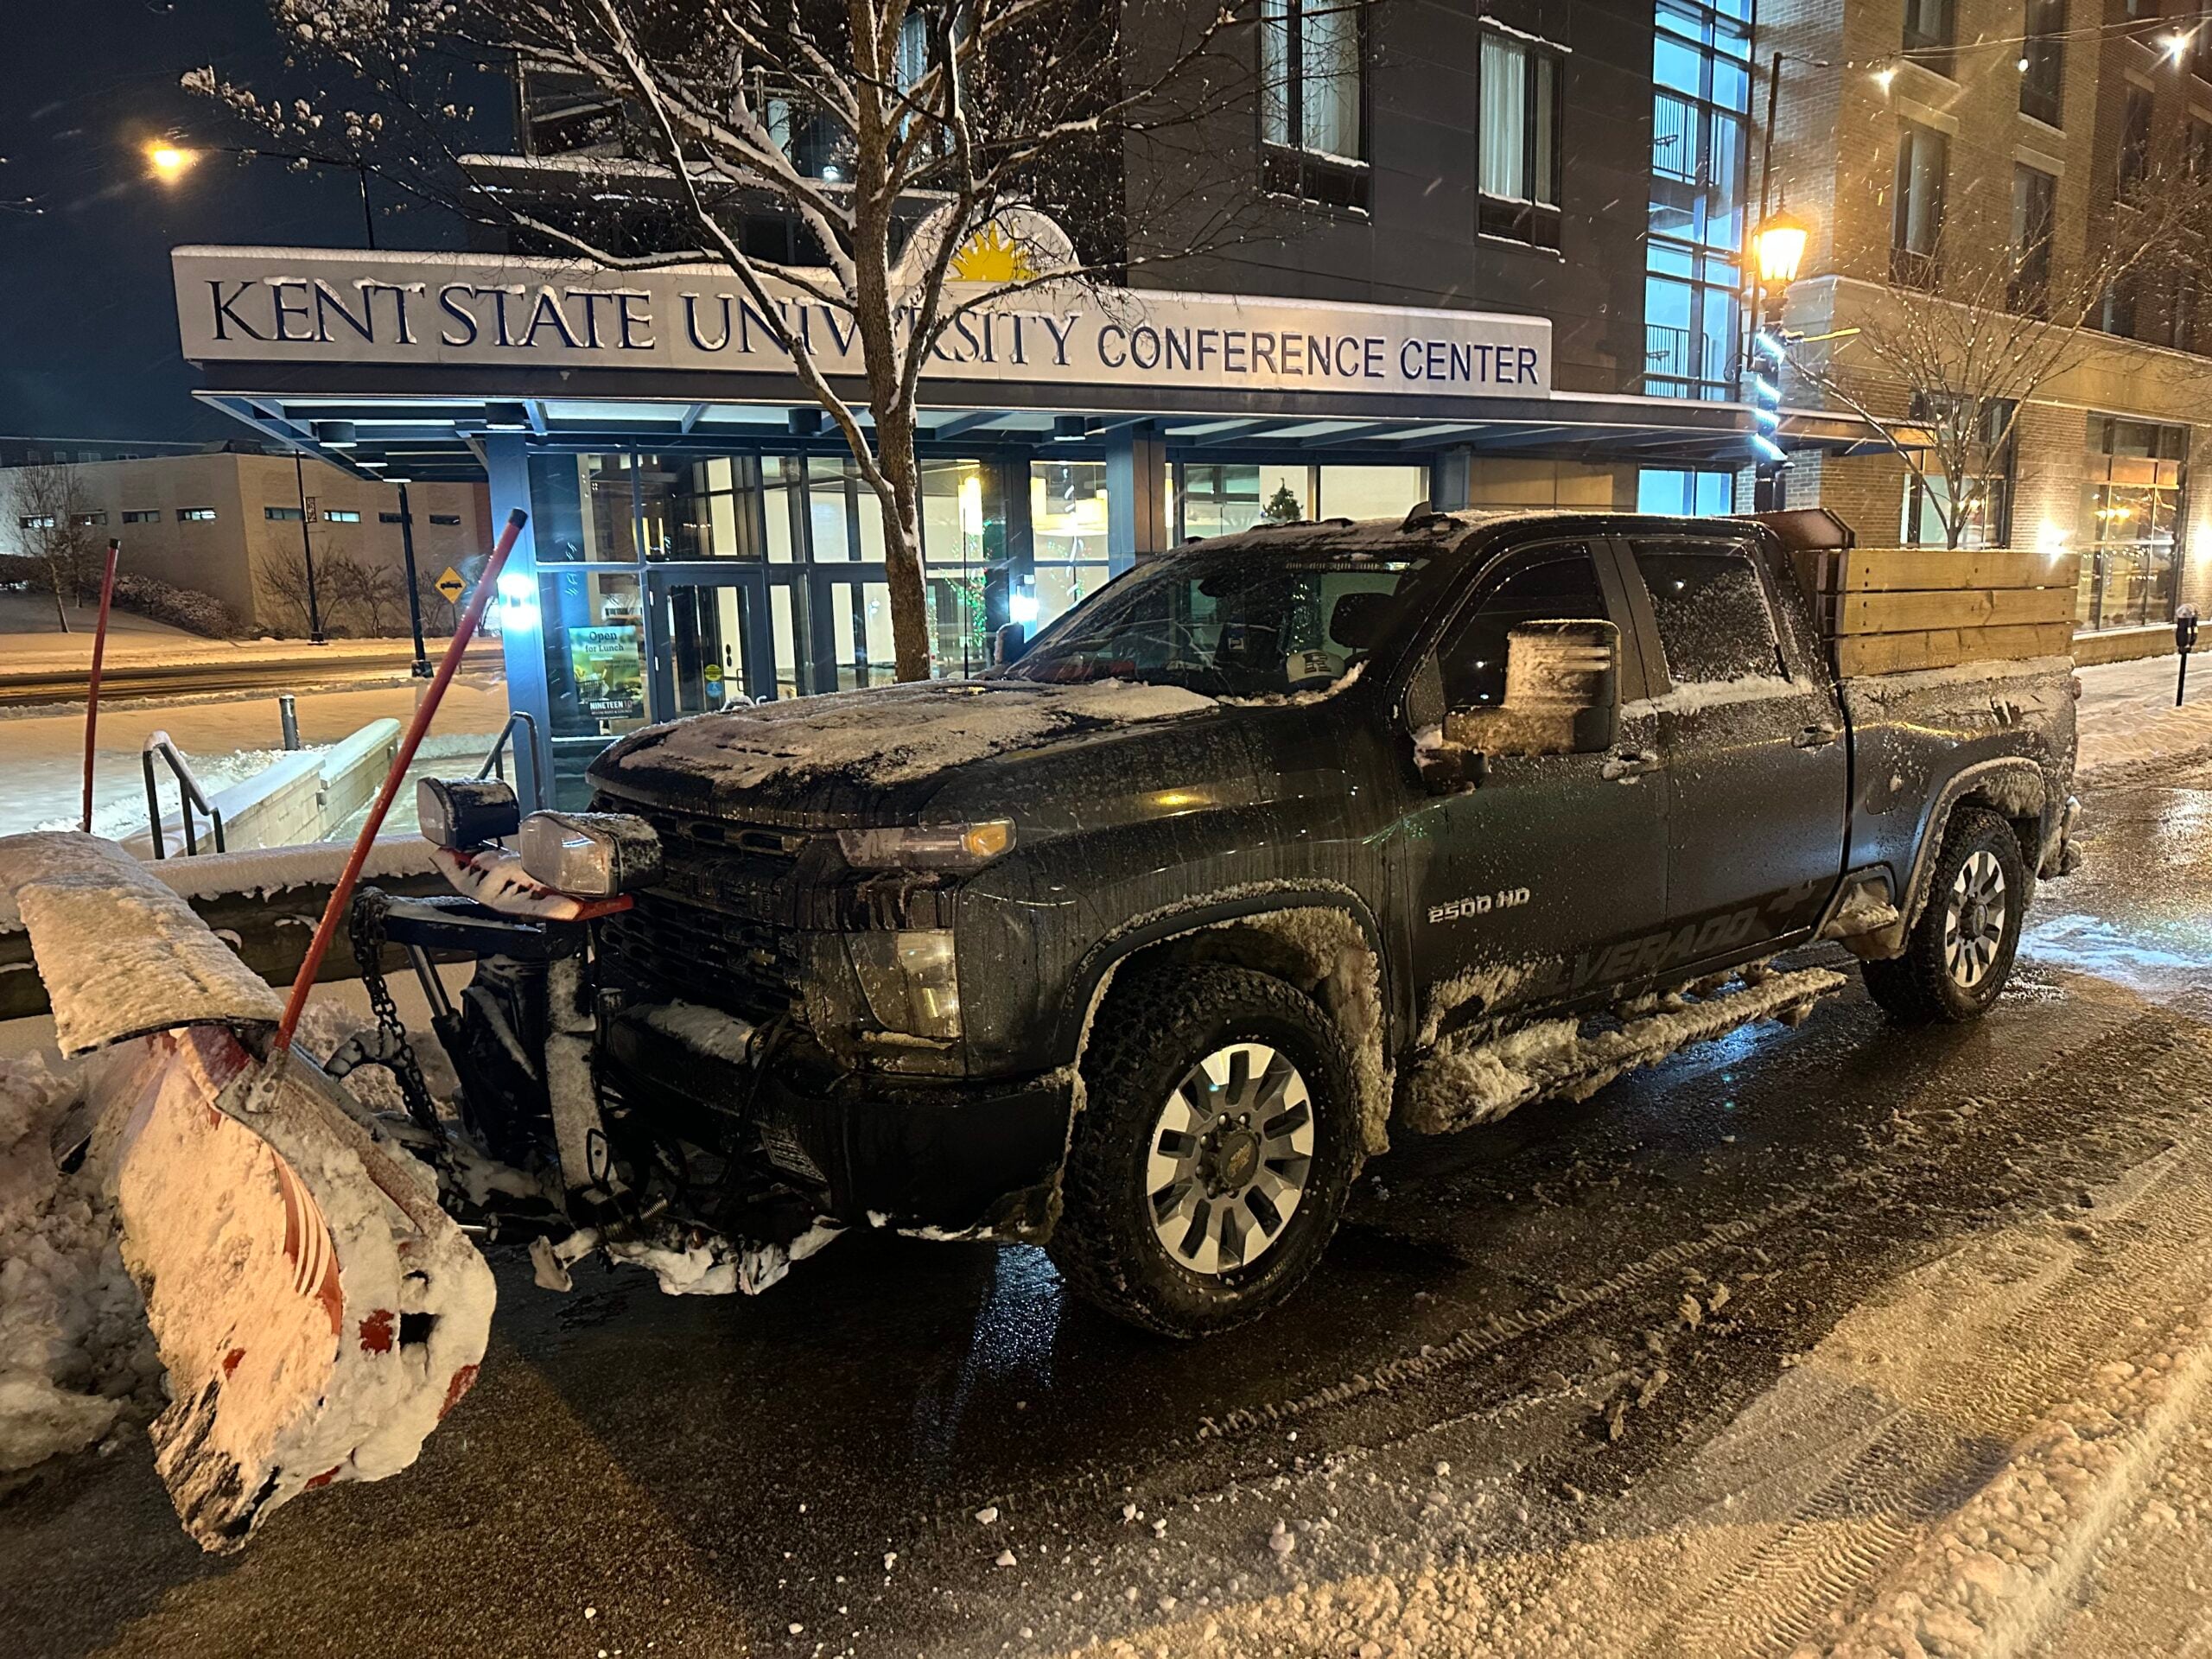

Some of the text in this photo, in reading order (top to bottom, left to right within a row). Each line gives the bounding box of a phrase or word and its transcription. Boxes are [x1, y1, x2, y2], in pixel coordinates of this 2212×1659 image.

[205, 275, 1539, 385] KENT STATE UNIVSITY CONFERENCE CENTER
[588, 631, 618, 644] Open
[598, 643, 624, 652] Lunch
[1427, 887, 1531, 924] 2500 HD
